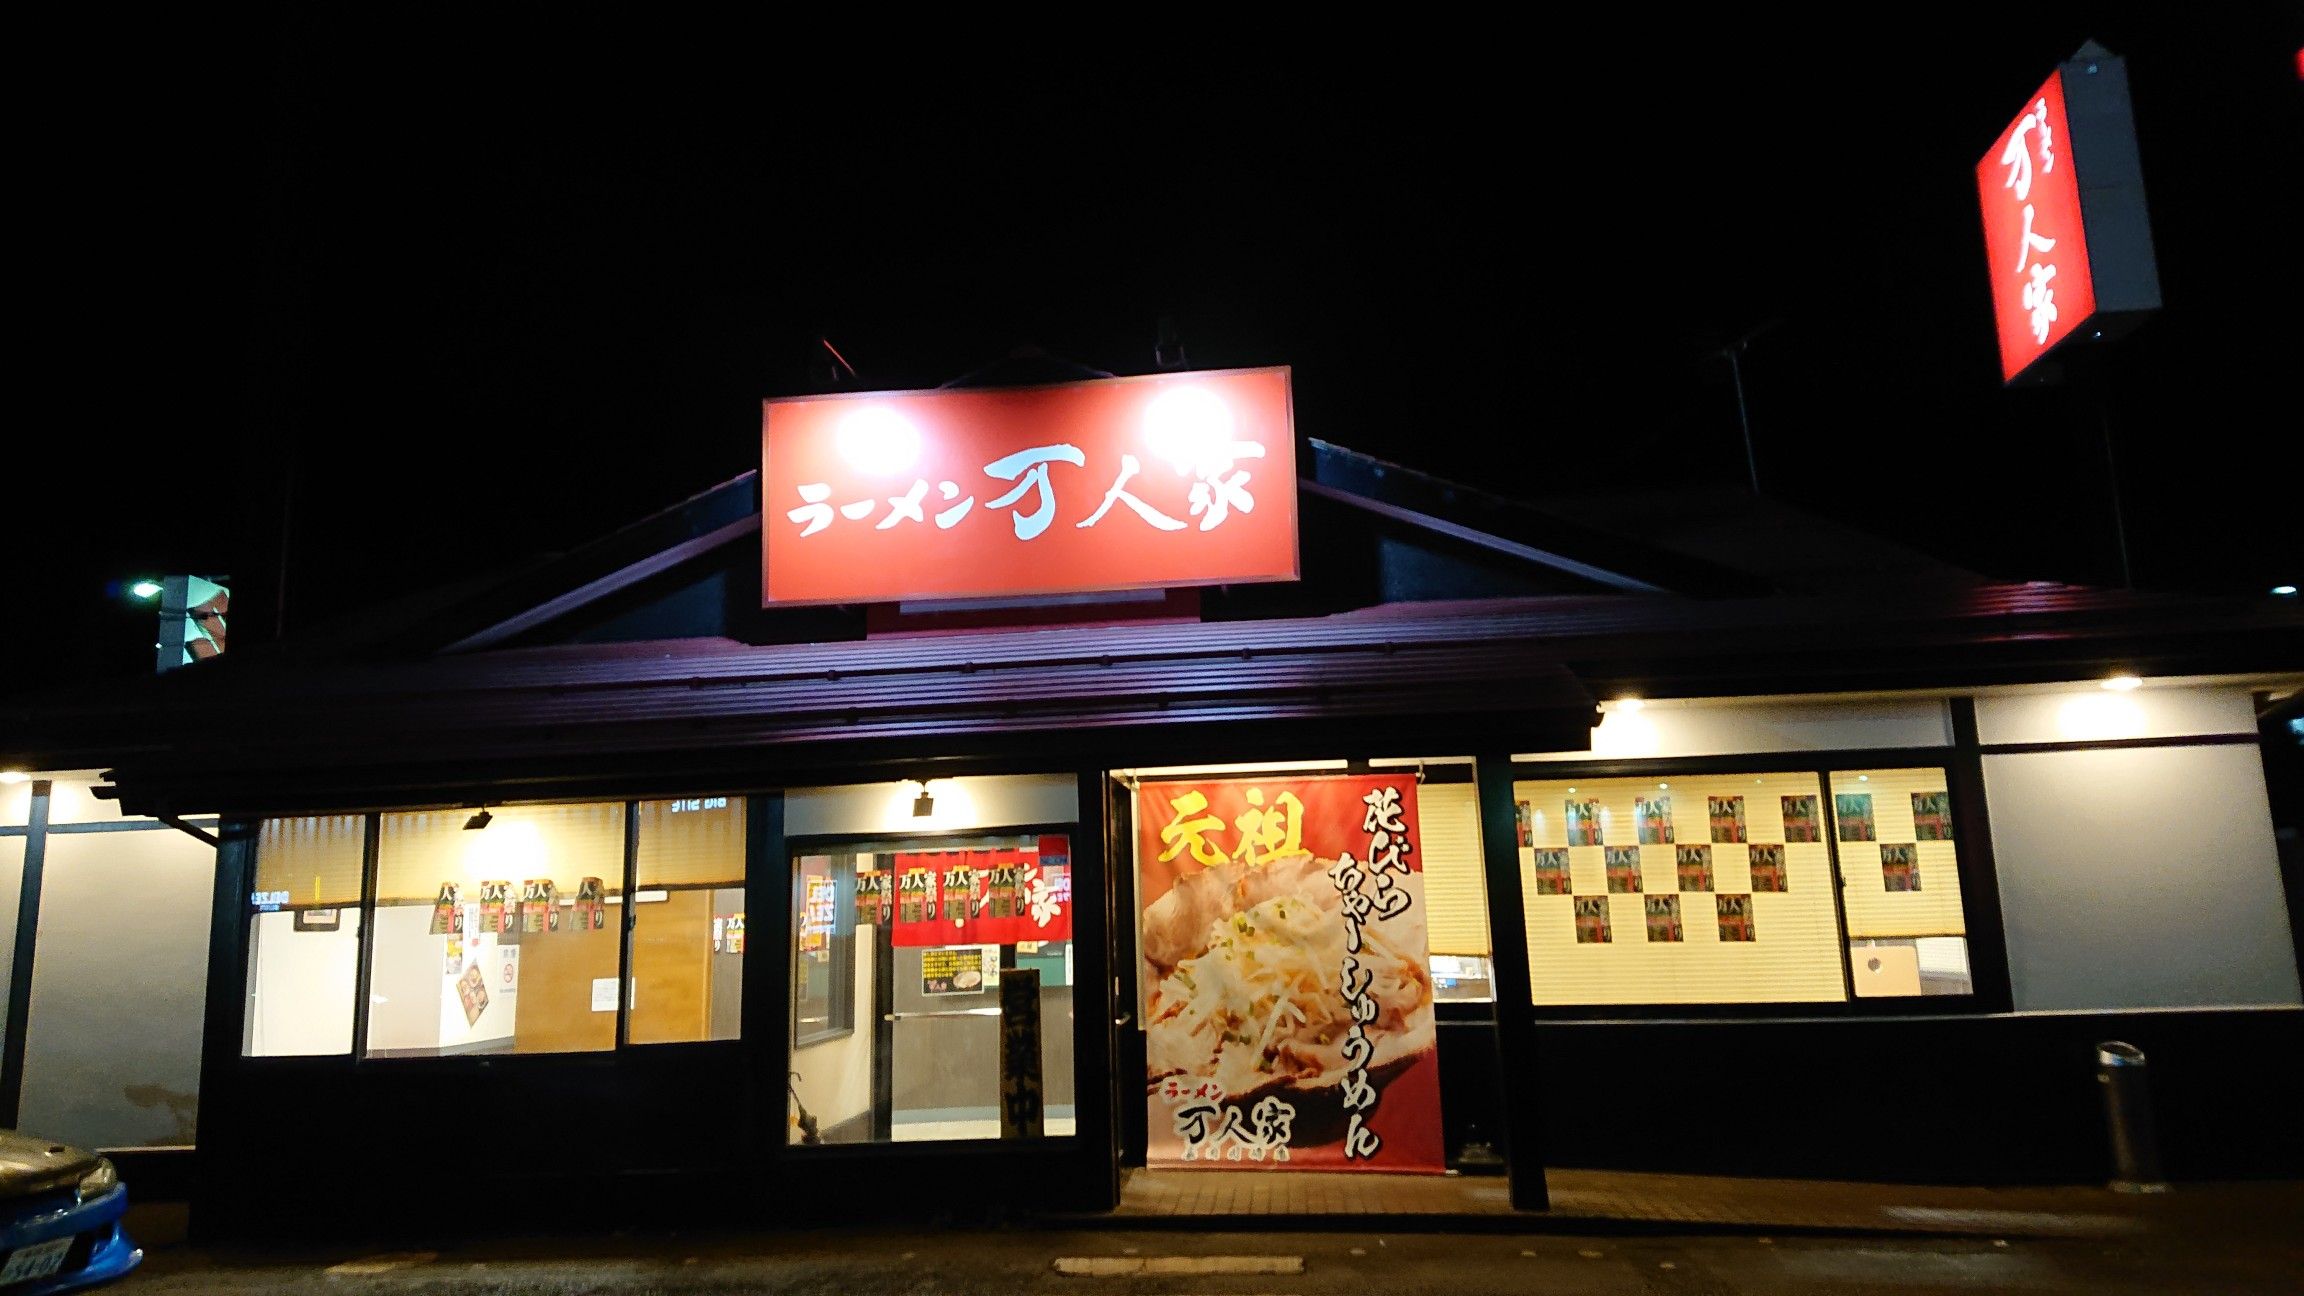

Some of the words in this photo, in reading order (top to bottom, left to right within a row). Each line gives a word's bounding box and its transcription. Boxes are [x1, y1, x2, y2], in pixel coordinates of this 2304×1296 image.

[2001, 113, 2058, 345] 万人家
[787, 479, 975, 537] ラーメン
[983, 440, 1266, 541] 万人家
[1157, 788, 1313, 868] 元祖
[1362, 786, 1413, 921] 花びら
[1164, 1081, 1223, 1101] ラーメン
[1178, 1103, 1291, 1145] 万人家
